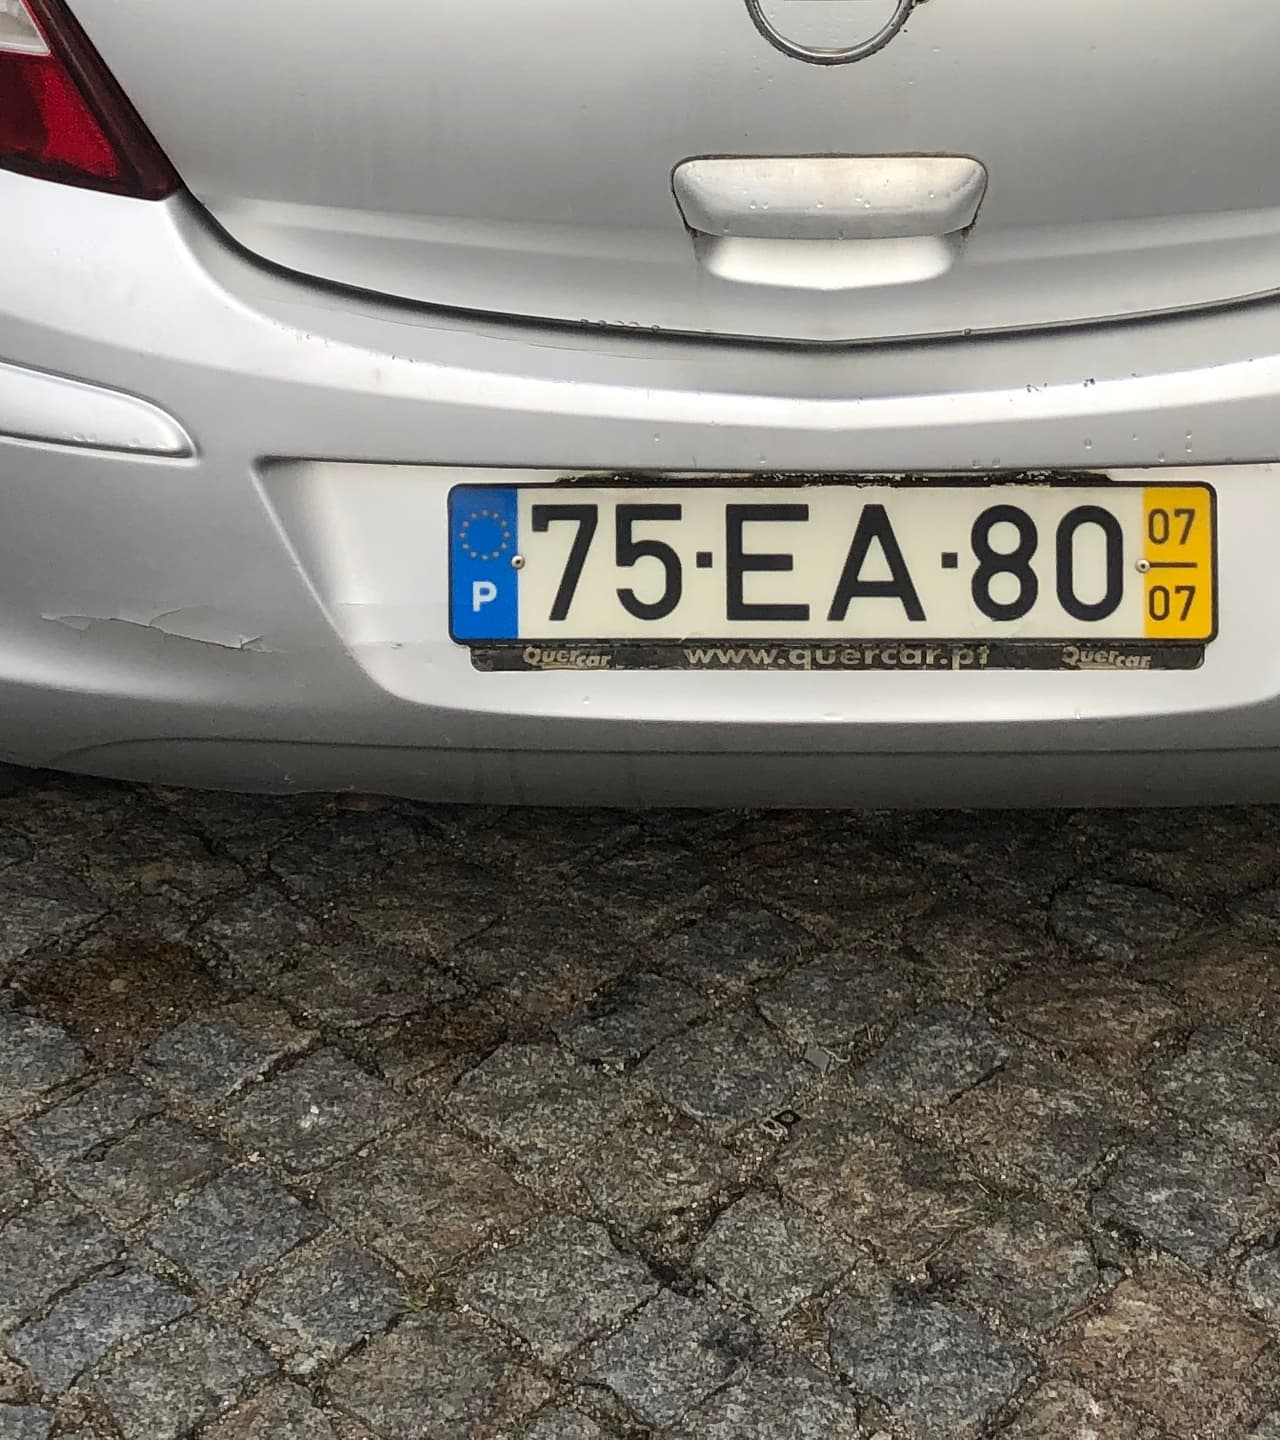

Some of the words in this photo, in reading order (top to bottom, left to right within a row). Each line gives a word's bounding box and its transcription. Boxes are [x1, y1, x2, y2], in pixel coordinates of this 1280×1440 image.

[1147, 508, 1197, 545] 07
[472, 581, 498, 612] P
[1147, 585, 1197, 621] 07
[683, 647, 991, 670] www.quercar.pt
